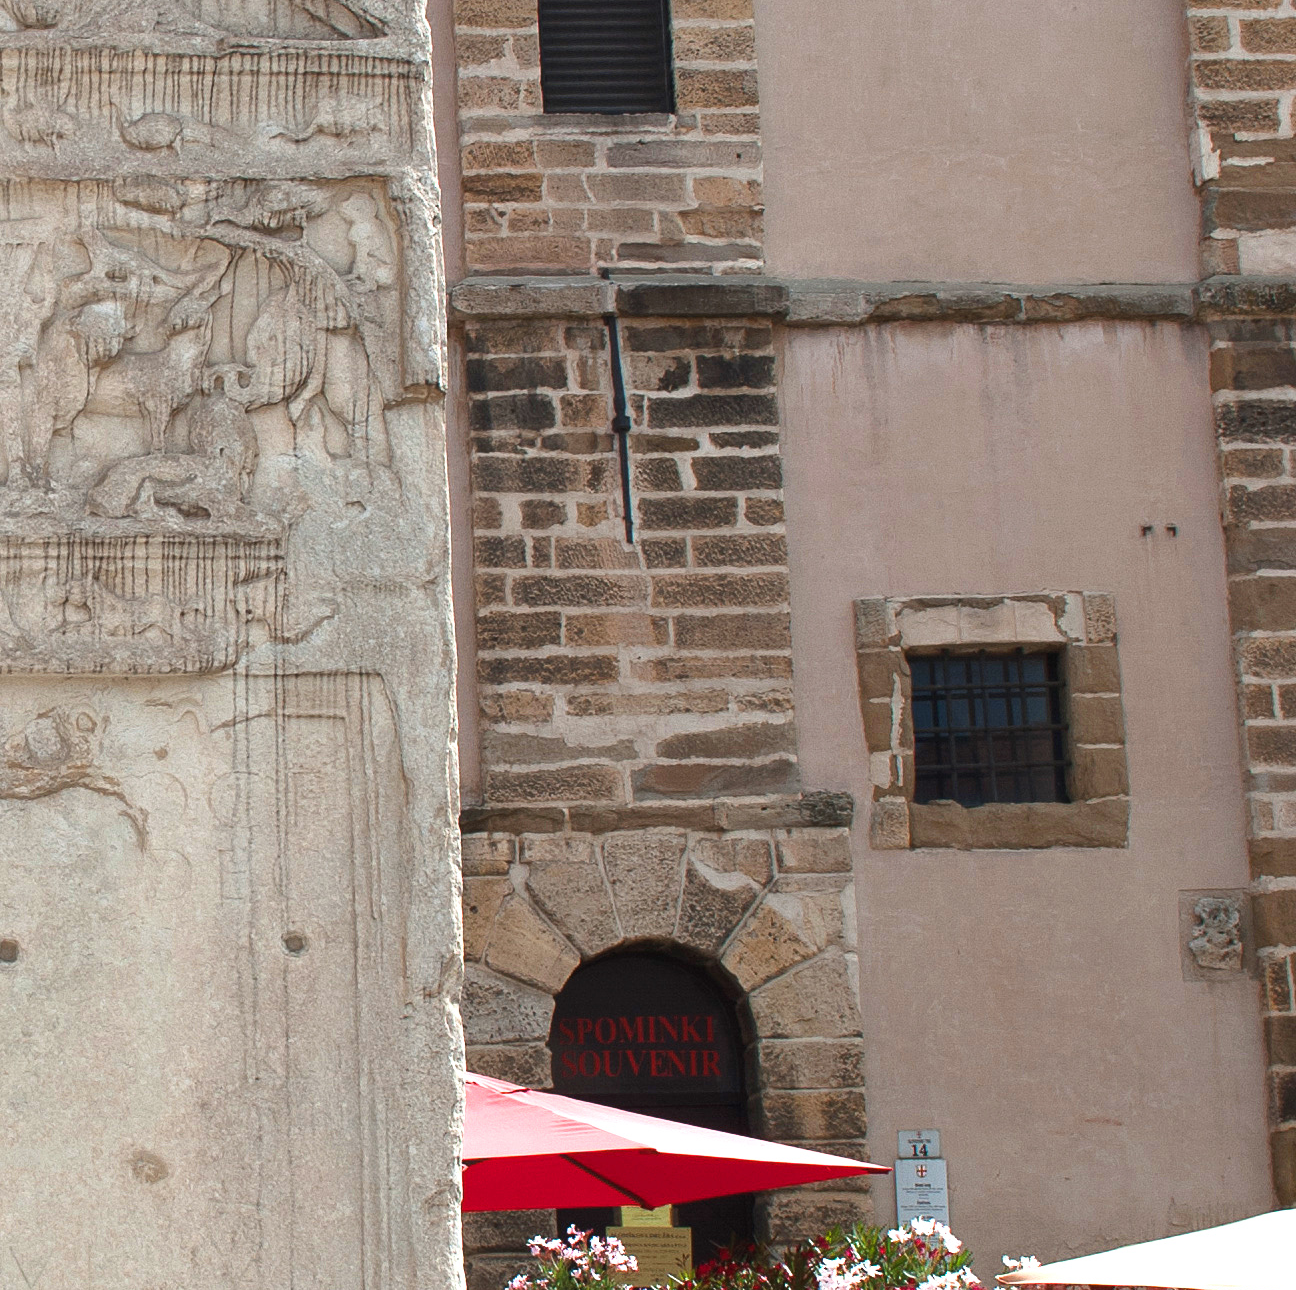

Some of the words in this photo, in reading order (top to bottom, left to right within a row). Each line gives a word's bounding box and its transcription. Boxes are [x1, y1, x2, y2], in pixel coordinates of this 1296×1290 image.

[559, 1015, 715, 1045] SPOMINKI
[561, 1050, 722, 1078] SOUVENIR
[911, 1144, 928, 1157] 14
